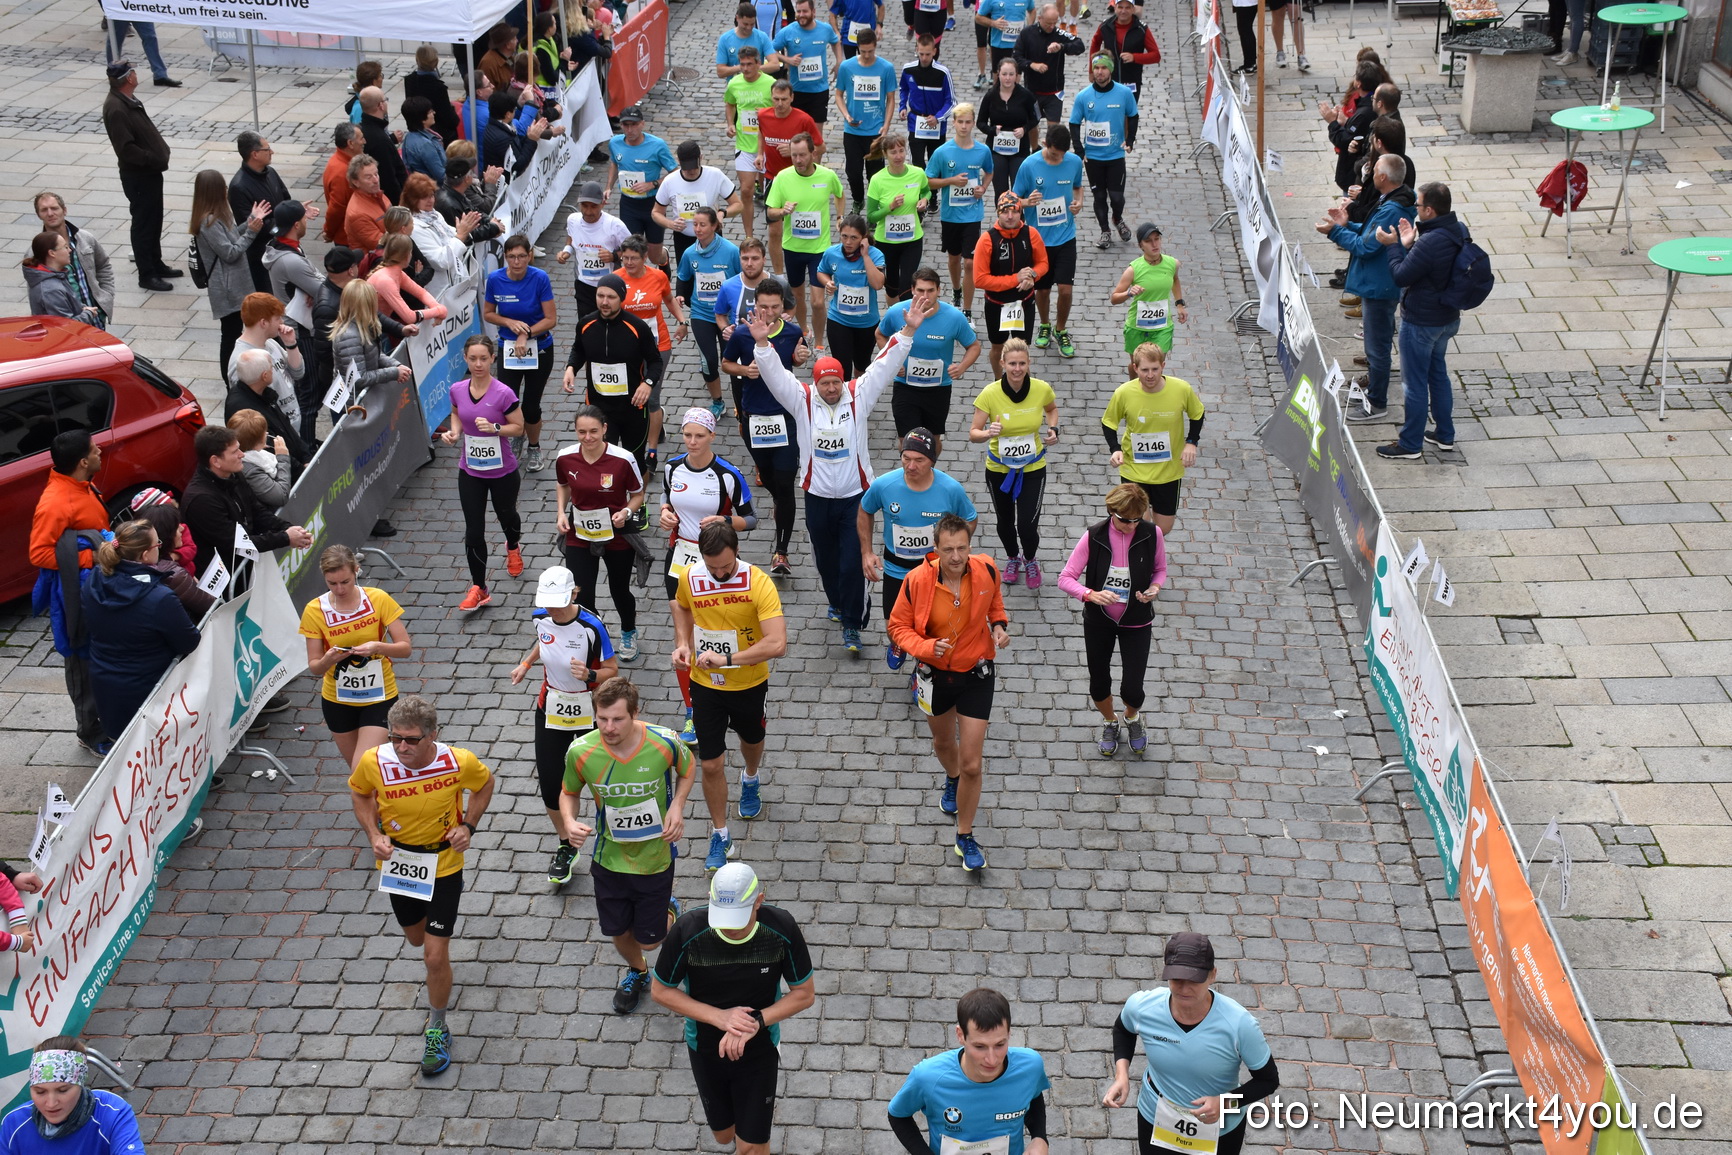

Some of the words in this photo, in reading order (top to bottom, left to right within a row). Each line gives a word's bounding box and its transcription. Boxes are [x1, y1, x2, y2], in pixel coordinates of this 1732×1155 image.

[121, 1, 176, 16] Vernetzt,
[179, 6, 197, 16] um
[199, 5, 219, 17] frei
[222, 9, 236, 19] zu
[239, 9, 268, 21] sein.
[801, 64, 819, 72] 2403
[1088, 128, 1106, 138] 2066
[954, 188, 975, 197] 2443
[683, 201, 701, 212] 229
[1041, 206, 1062, 216] 2444
[795, 219, 817, 228] 2304
[890, 223, 911, 232] 2305
[583, 259, 605, 269] 2245
[700, 281, 722, 291] 2268
[842, 294, 865, 304] 2378
[1007, 309, 1022, 319] 410
[1142, 309, 1164, 319] 2246
[912, 366, 938, 377] 2247
[599, 373, 619, 384] 290
[754, 424, 782, 436] 2358
[816, 438, 845, 450] 2244
[1004, 443, 1032, 457] 2202
[1137, 440, 1165, 452] 2146
[469, 446, 496, 458] 2056
[580, 519, 602, 530] 165
[899, 536, 929, 547] 2300
[207, 569, 223, 591] swn
[694, 599, 721, 609] MAX
[723, 594, 753, 605] BÖGL
[329, 627, 351, 638] MAX
[353, 616, 379, 632] BÖGL
[699, 639, 731, 654] 2636
[268, 667, 288, 689] GmbH
[342, 673, 377, 690] 2617
[351, 690, 370, 698] Marina
[556, 703, 582, 717] 248
[385, 786, 419, 800] MAX
[423, 774, 462, 795] BÖGL
[593, 778, 660, 798] BOCK
[614, 813, 654, 829] 2749
[389, 860, 429, 881] 2630
[397, 879, 418, 890] Herbert
[80, 923, 136, 1009] Service-Line:
[1510, 947, 1520, 963] für
[1516, 961, 1527, 977] die
[1521, 943, 1544, 990] Neumarkts
[1539, 989, 1564, 1031] moderner
[994, 1109, 1027, 1122] BOCK
[1174, 1118, 1198, 1137] 46
[1175, 1136, 1193, 1147] Petra
